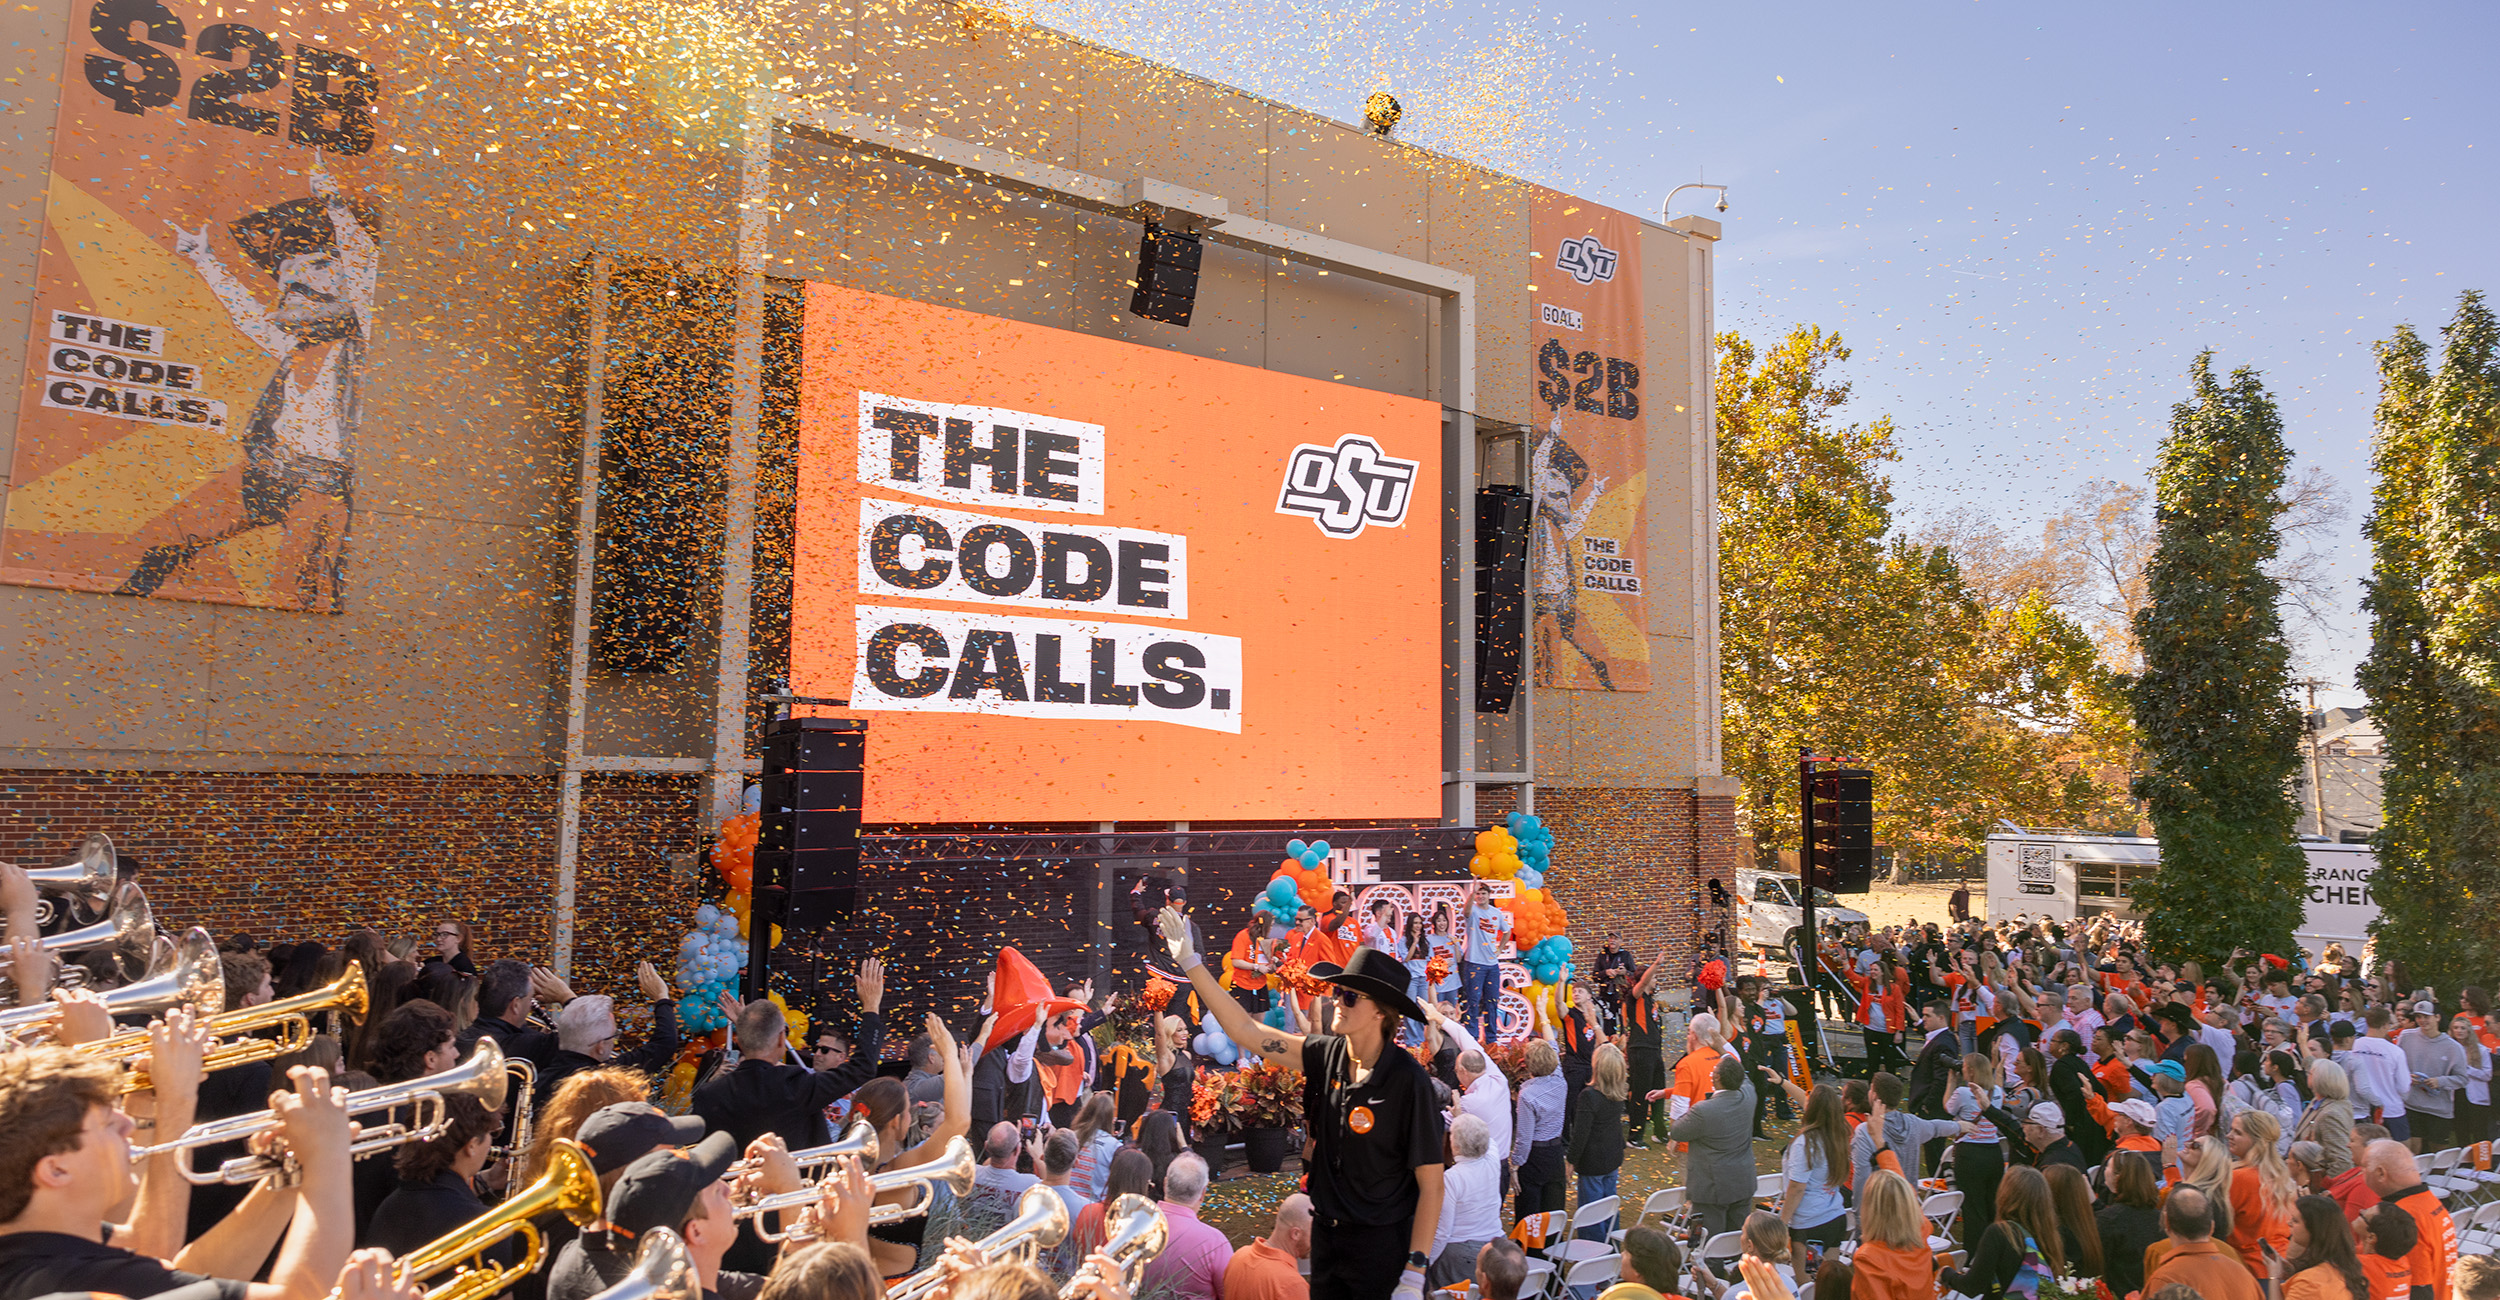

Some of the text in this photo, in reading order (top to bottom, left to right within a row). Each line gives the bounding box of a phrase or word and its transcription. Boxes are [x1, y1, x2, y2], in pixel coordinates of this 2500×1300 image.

[84, 0, 381, 156] $2B
[1556, 236, 1618, 284] OSU
[58, 314, 152, 352] THE
[1543, 306, 1581, 330] GOAL:
[53, 348, 195, 389] CODE
[1538, 338, 1639, 421] $2B
[49, 381, 221, 426] CALLS.
[873, 406, 1080, 503] THE
[1278, 436, 1418, 536] OSU
[870, 514, 1169, 609] CODE
[1584, 537, 1615, 554] THE
[1584, 556, 1632, 573] CODE
[866, 624, 1230, 710] CALLS.
[1322, 884, 1516, 960] ODE
